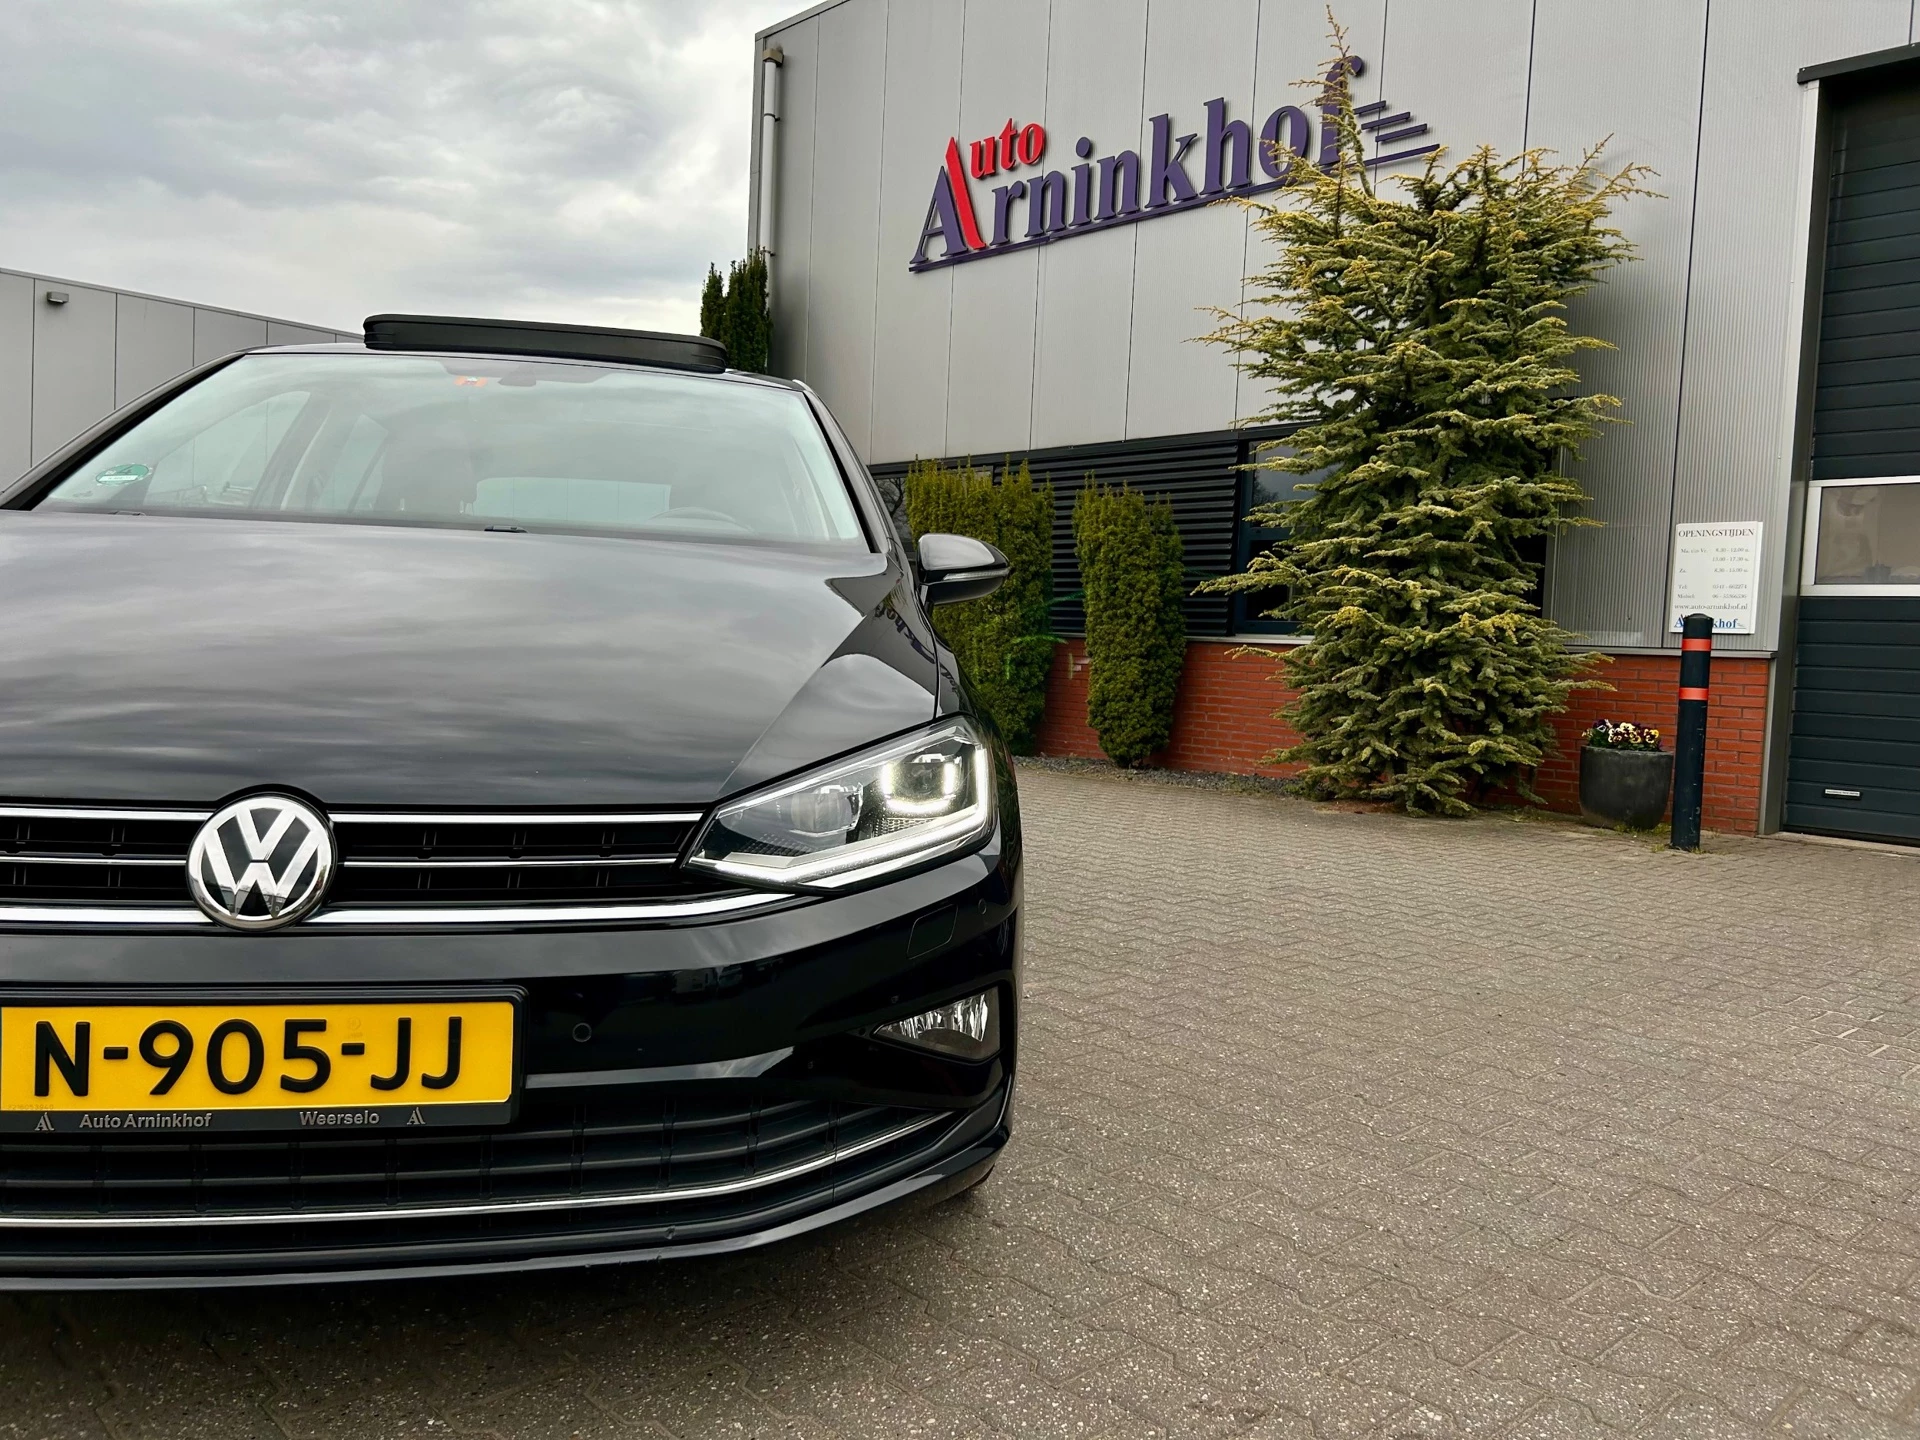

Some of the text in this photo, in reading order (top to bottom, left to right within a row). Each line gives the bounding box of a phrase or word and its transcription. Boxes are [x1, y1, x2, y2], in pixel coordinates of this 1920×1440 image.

[909, 55, 1363, 265] Arninkhof
[1678, 528, 1755, 538] OPENINGSTIJDEN
[34, 1016, 463, 1097] N-905-JJ
[79, 1112, 213, 1128] Auto Arninkhof
[299, 1109, 380, 1126] Weerselo
